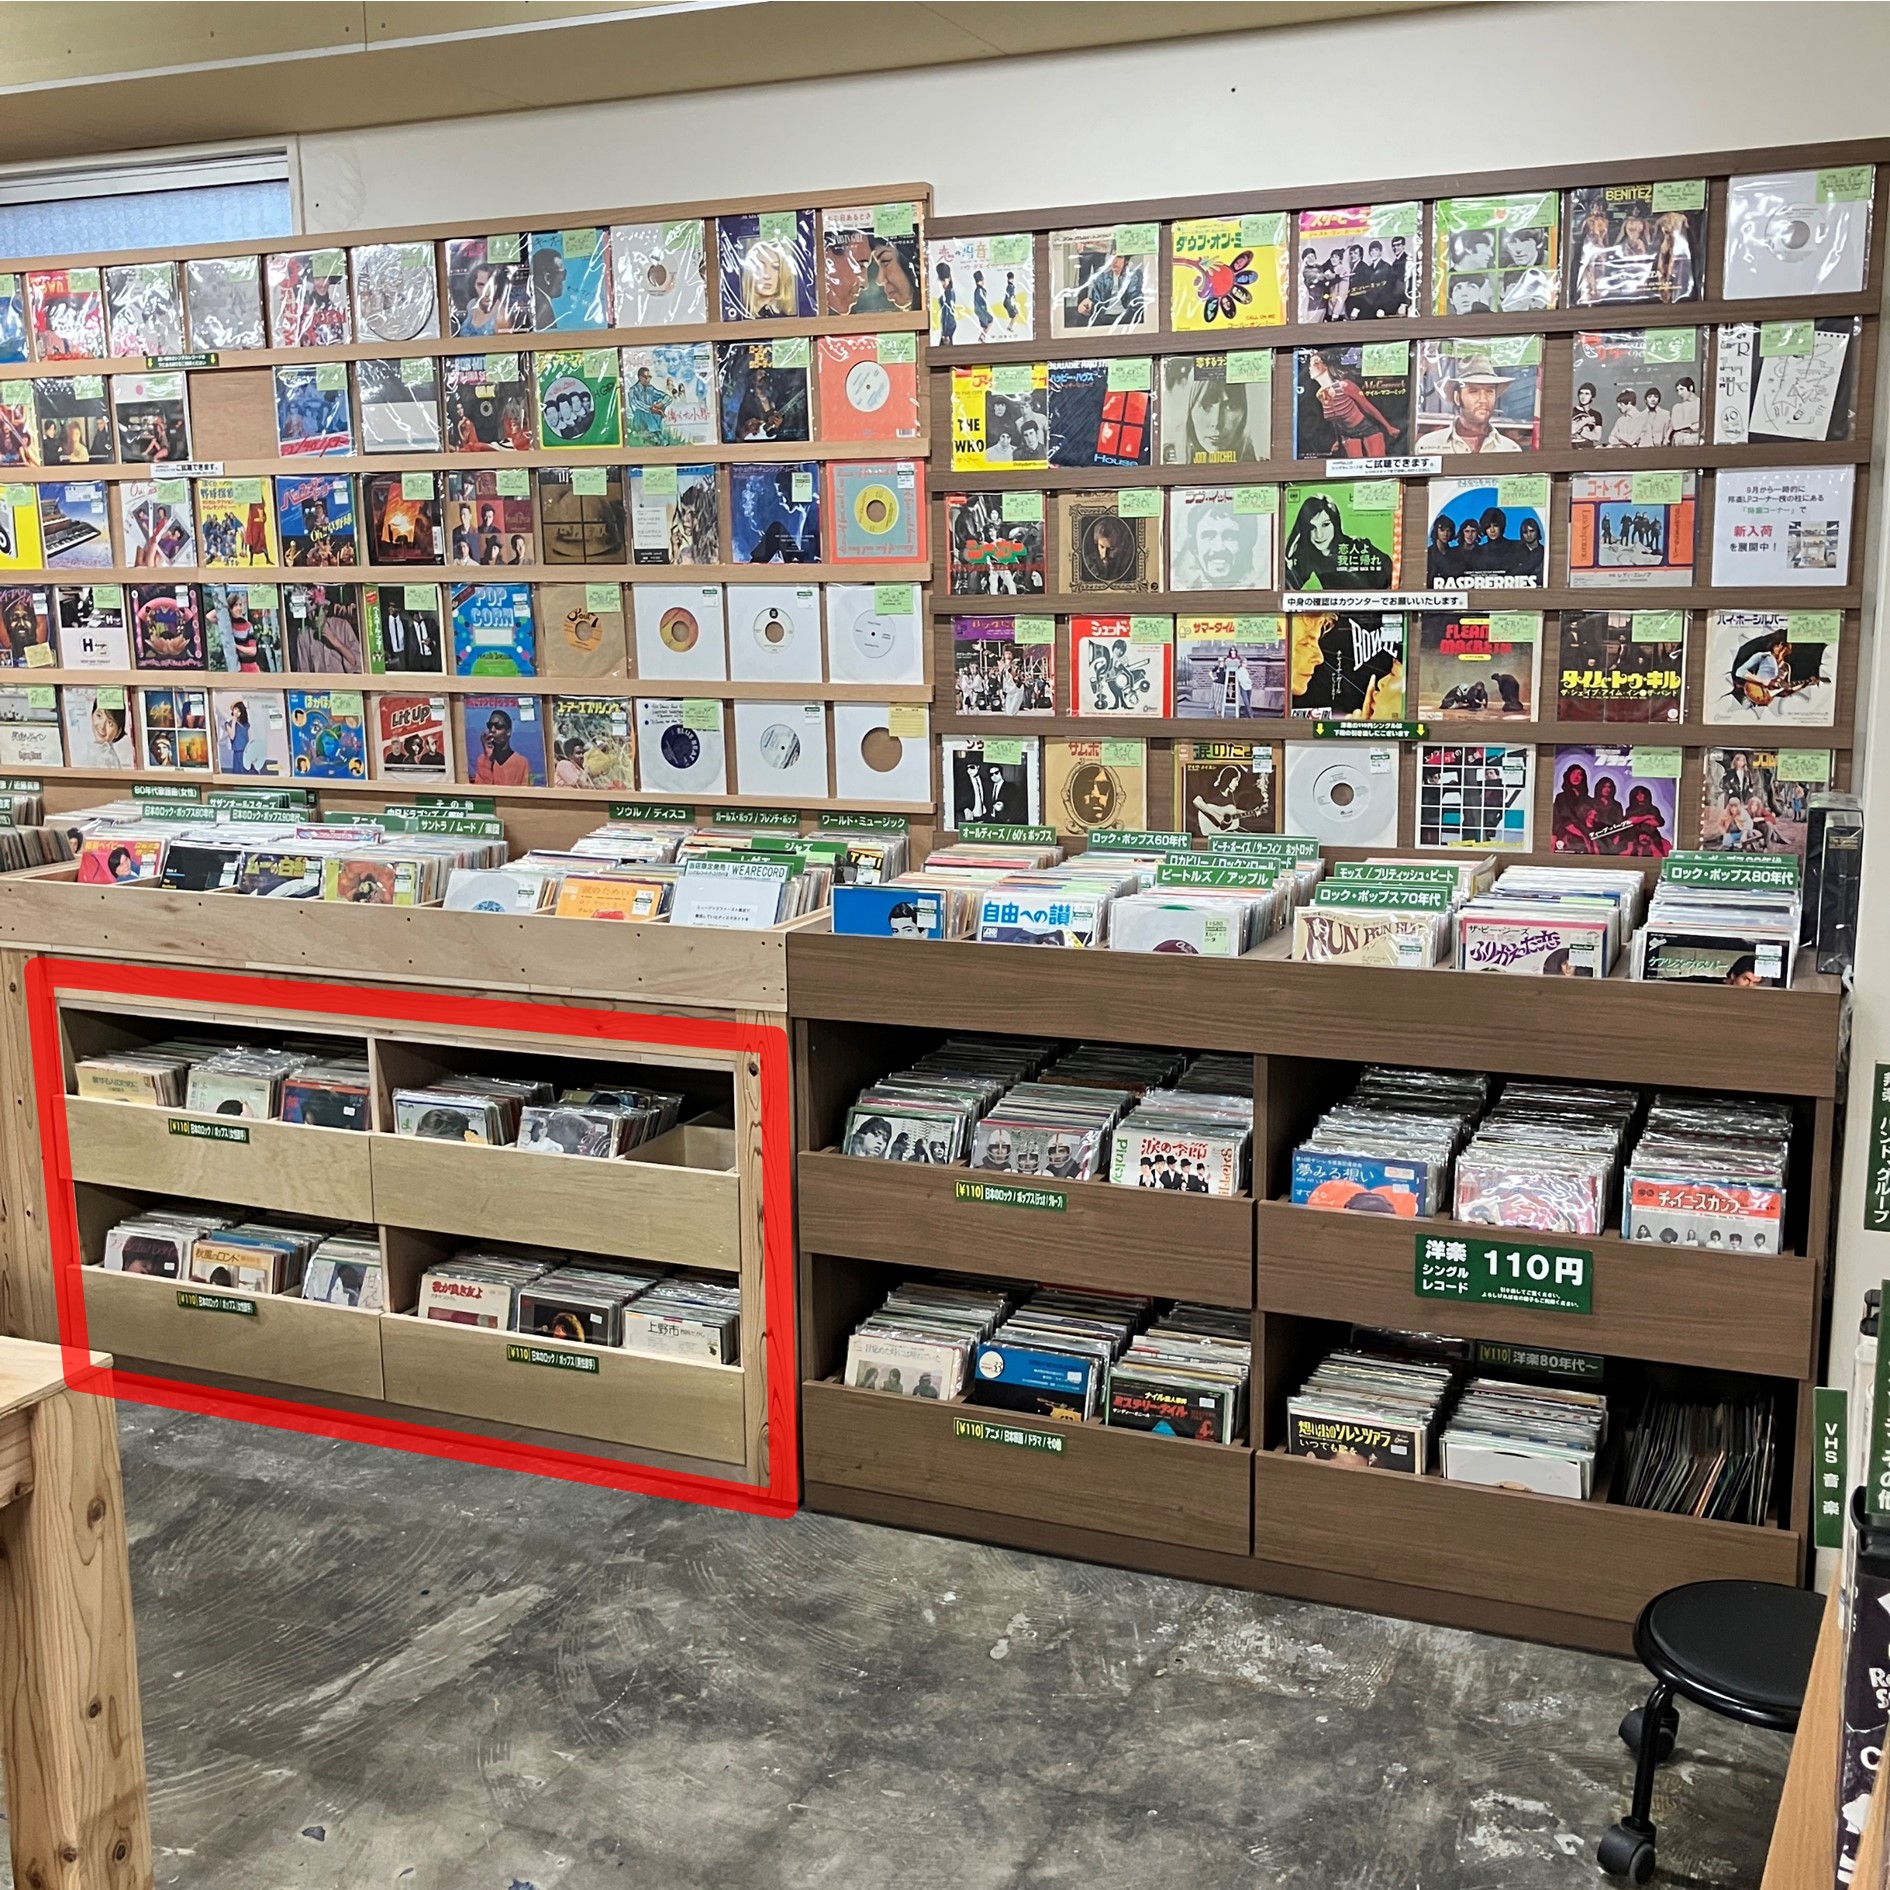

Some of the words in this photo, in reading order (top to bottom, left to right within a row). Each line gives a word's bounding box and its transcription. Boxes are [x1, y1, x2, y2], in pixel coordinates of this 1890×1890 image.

[1606, 189, 1652, 202] BENITEZ
[957, 418, 980, 432] THE
[955, 440, 985, 453] WHO
[1094, 453, 1139, 466] House
[1194, 452, 1208, 464] JONI
[1209, 450, 1238, 463] MITCHELL
[1365, 458, 1434, 470] ご試聴できます。
[1733, 525, 1773, 537] 新入荷
[1337, 543, 1370, 555] 恋人よ
[1336, 554, 1383, 567] 我に帰れ
[1434, 575, 1537, 588] RASPBERRIES
[475, 587, 508, 607] POP
[1287, 595, 1464, 608] 中身の確認はカウンターでお願いいたします。
[471, 607, 515, 628] CORN
[1193, 621, 1234, 634] サマータイム
[1560, 670, 1681, 689] タイム・トゥ・キル
[209, 797, 277, 809] サザンオールスターズ
[615, 806, 642, 818] ソウル
[653, 807, 686, 821] ディスコ
[822, 813, 906, 829] ワールド・ミュージック
[421, 820, 447, 832] サントラ
[457, 822, 477, 833] ムード
[963, 826, 1005, 840] オールディーズ
[1028, 828, 1053, 842] ポップス
[784, 842, 814, 852] ジャズ
[1091, 832, 1188, 848] ロック・ポップス60年代
[732, 864, 785, 878] WEARECORD
[1161, 867, 1212, 882] ビートルズ
[1227, 870, 1269, 885] アップル
[1339, 866, 1362, 879] モッズ
[1376, 867, 1454, 882] ブリティッシュ・ビート
[1671, 867, 1794, 885] ロック・ポップス80年代
[1320, 889, 1441, 907] ロック・ポップス70年代
[982, 900, 1072, 927] 自由への讃
[1467, 924, 1530, 936] ザ・ビー・ジーズ
[1140, 1137, 1208, 1160] 涙の季節
[1111, 1138, 1129, 1184] Pinky
[1295, 1162, 1375, 1183] 夢みる想い
[955, 1181, 984, 1200] [¥110]
[1424, 1238, 1468, 1262] 洋楽
[1422, 1264, 1469, 1280] シングル
[1483, 1250, 1584, 1287] 110円
[431, 1280, 483, 1300] 我が良き友よ
[1422, 1279, 1469, 1294] レコード
[647, 1321, 680, 1337] 上野市
[508, 1345, 531, 1362] [¥110]
[956, 1420, 984, 1439] [¥110]
[1297, 1420, 1392, 1448] 想い出のソレンツァラ
[1824, 1422, 1839, 1463] VHS
